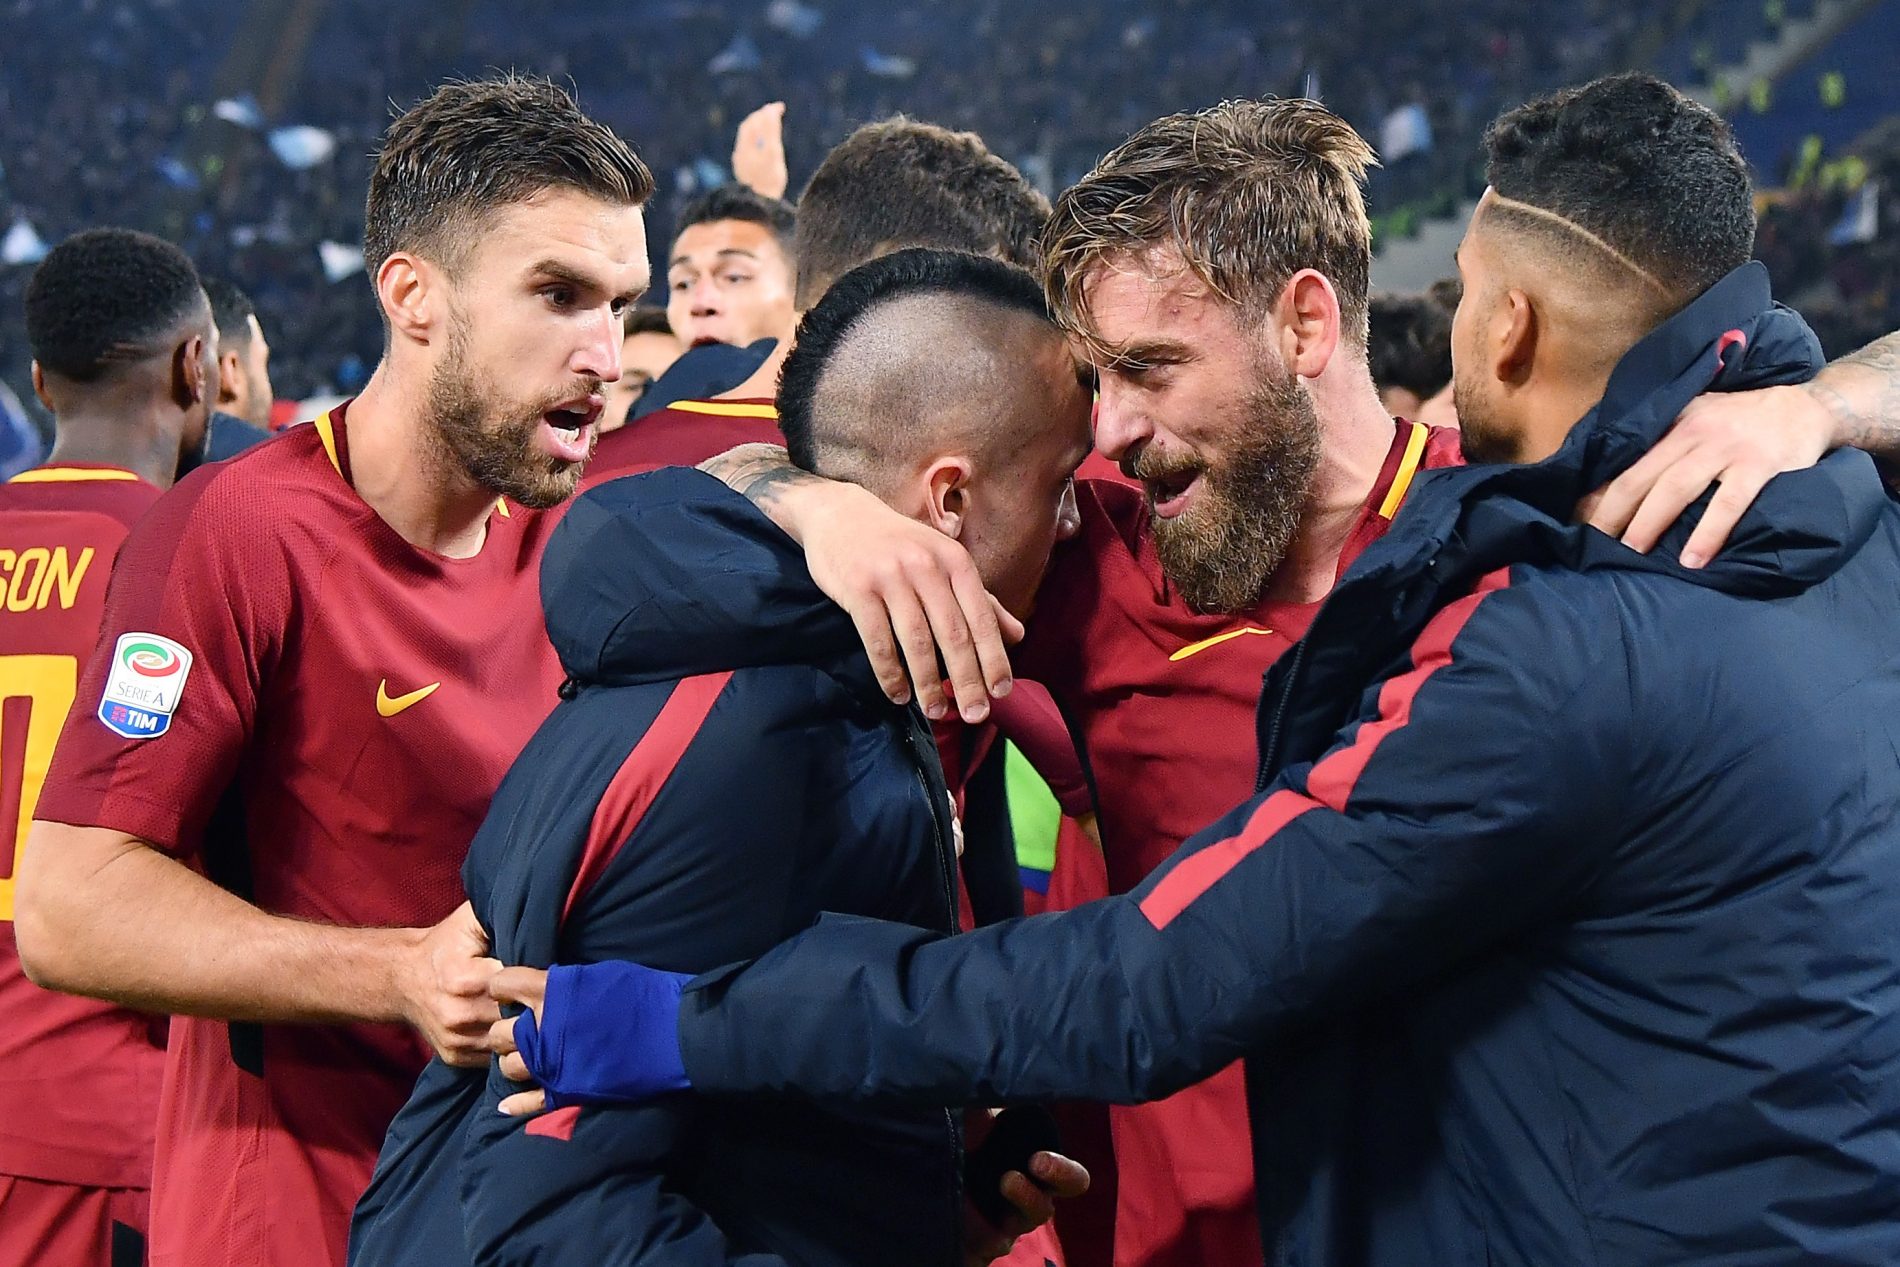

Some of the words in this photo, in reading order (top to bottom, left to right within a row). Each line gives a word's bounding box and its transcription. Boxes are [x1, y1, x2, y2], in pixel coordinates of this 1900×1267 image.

[116, 681, 152, 701] SERIE
[152, 692, 164, 707] A
[127, 709, 158, 731] TIM
